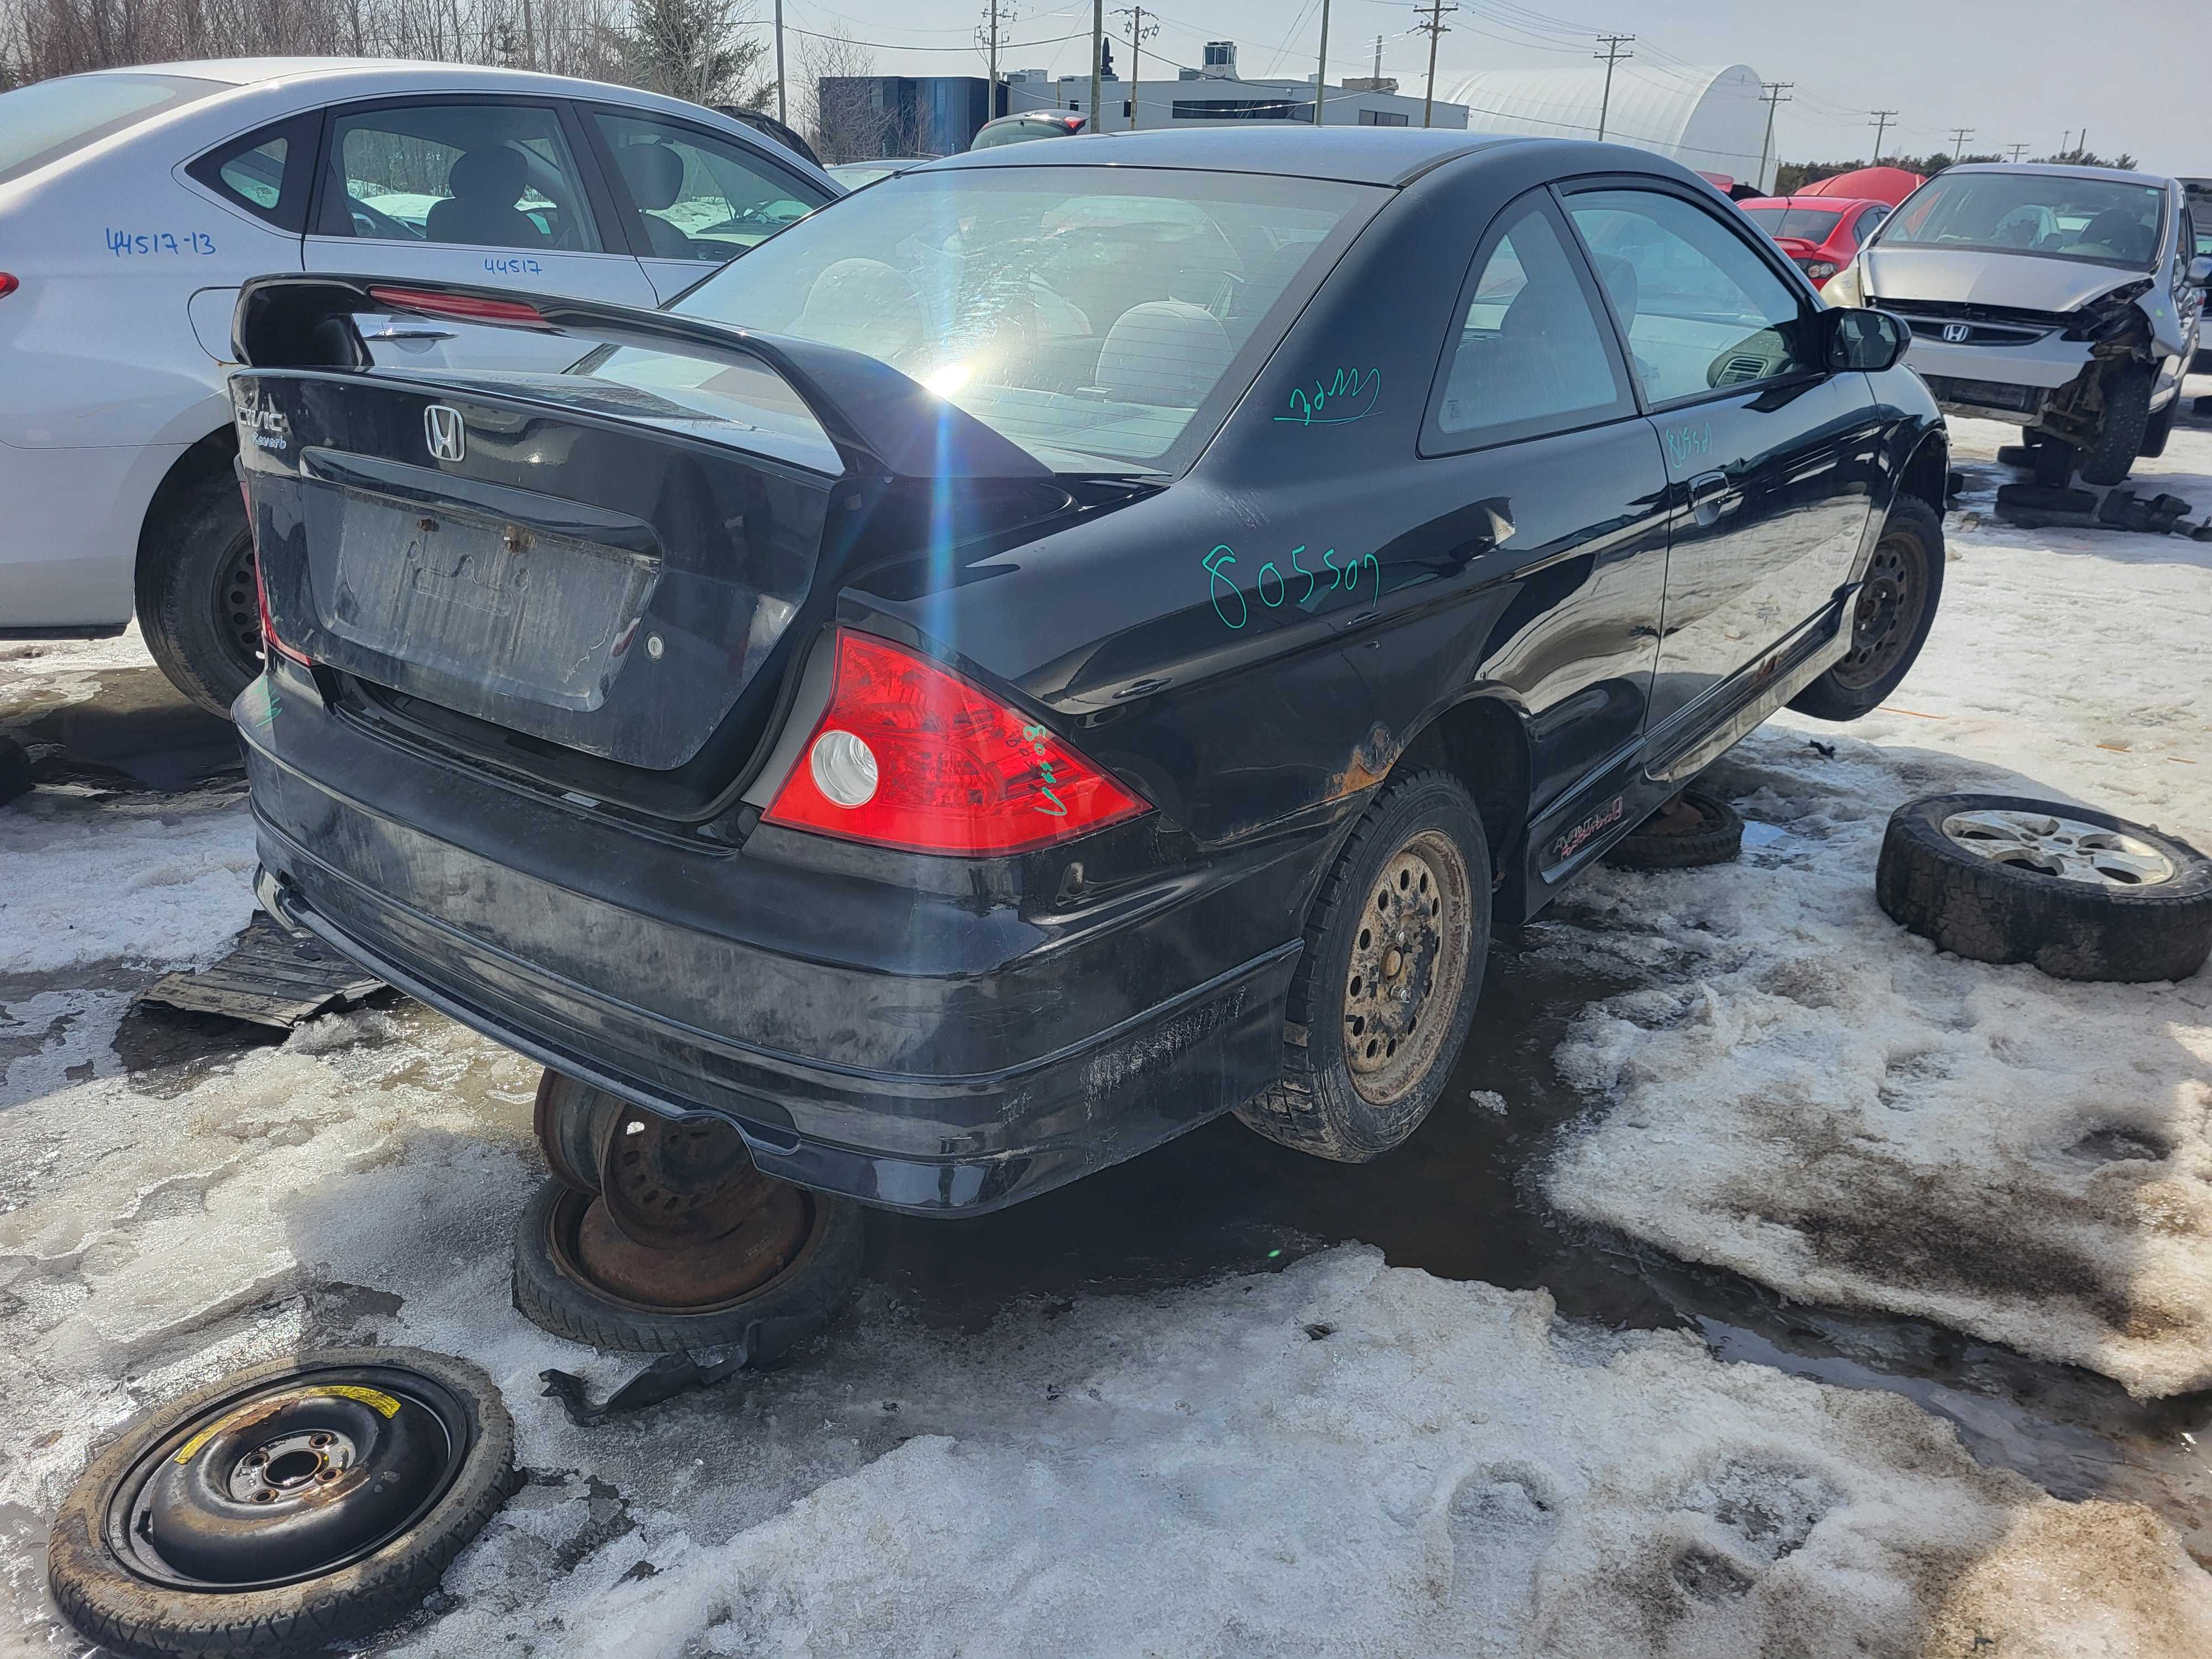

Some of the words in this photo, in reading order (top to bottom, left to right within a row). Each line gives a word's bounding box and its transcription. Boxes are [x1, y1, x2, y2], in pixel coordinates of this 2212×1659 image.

[106, 226, 216, 257] 44517-13
[484, 257, 543, 275] 44517
[237, 406, 283, 432] CIVIC
[252, 431, 287, 450] Reverb
